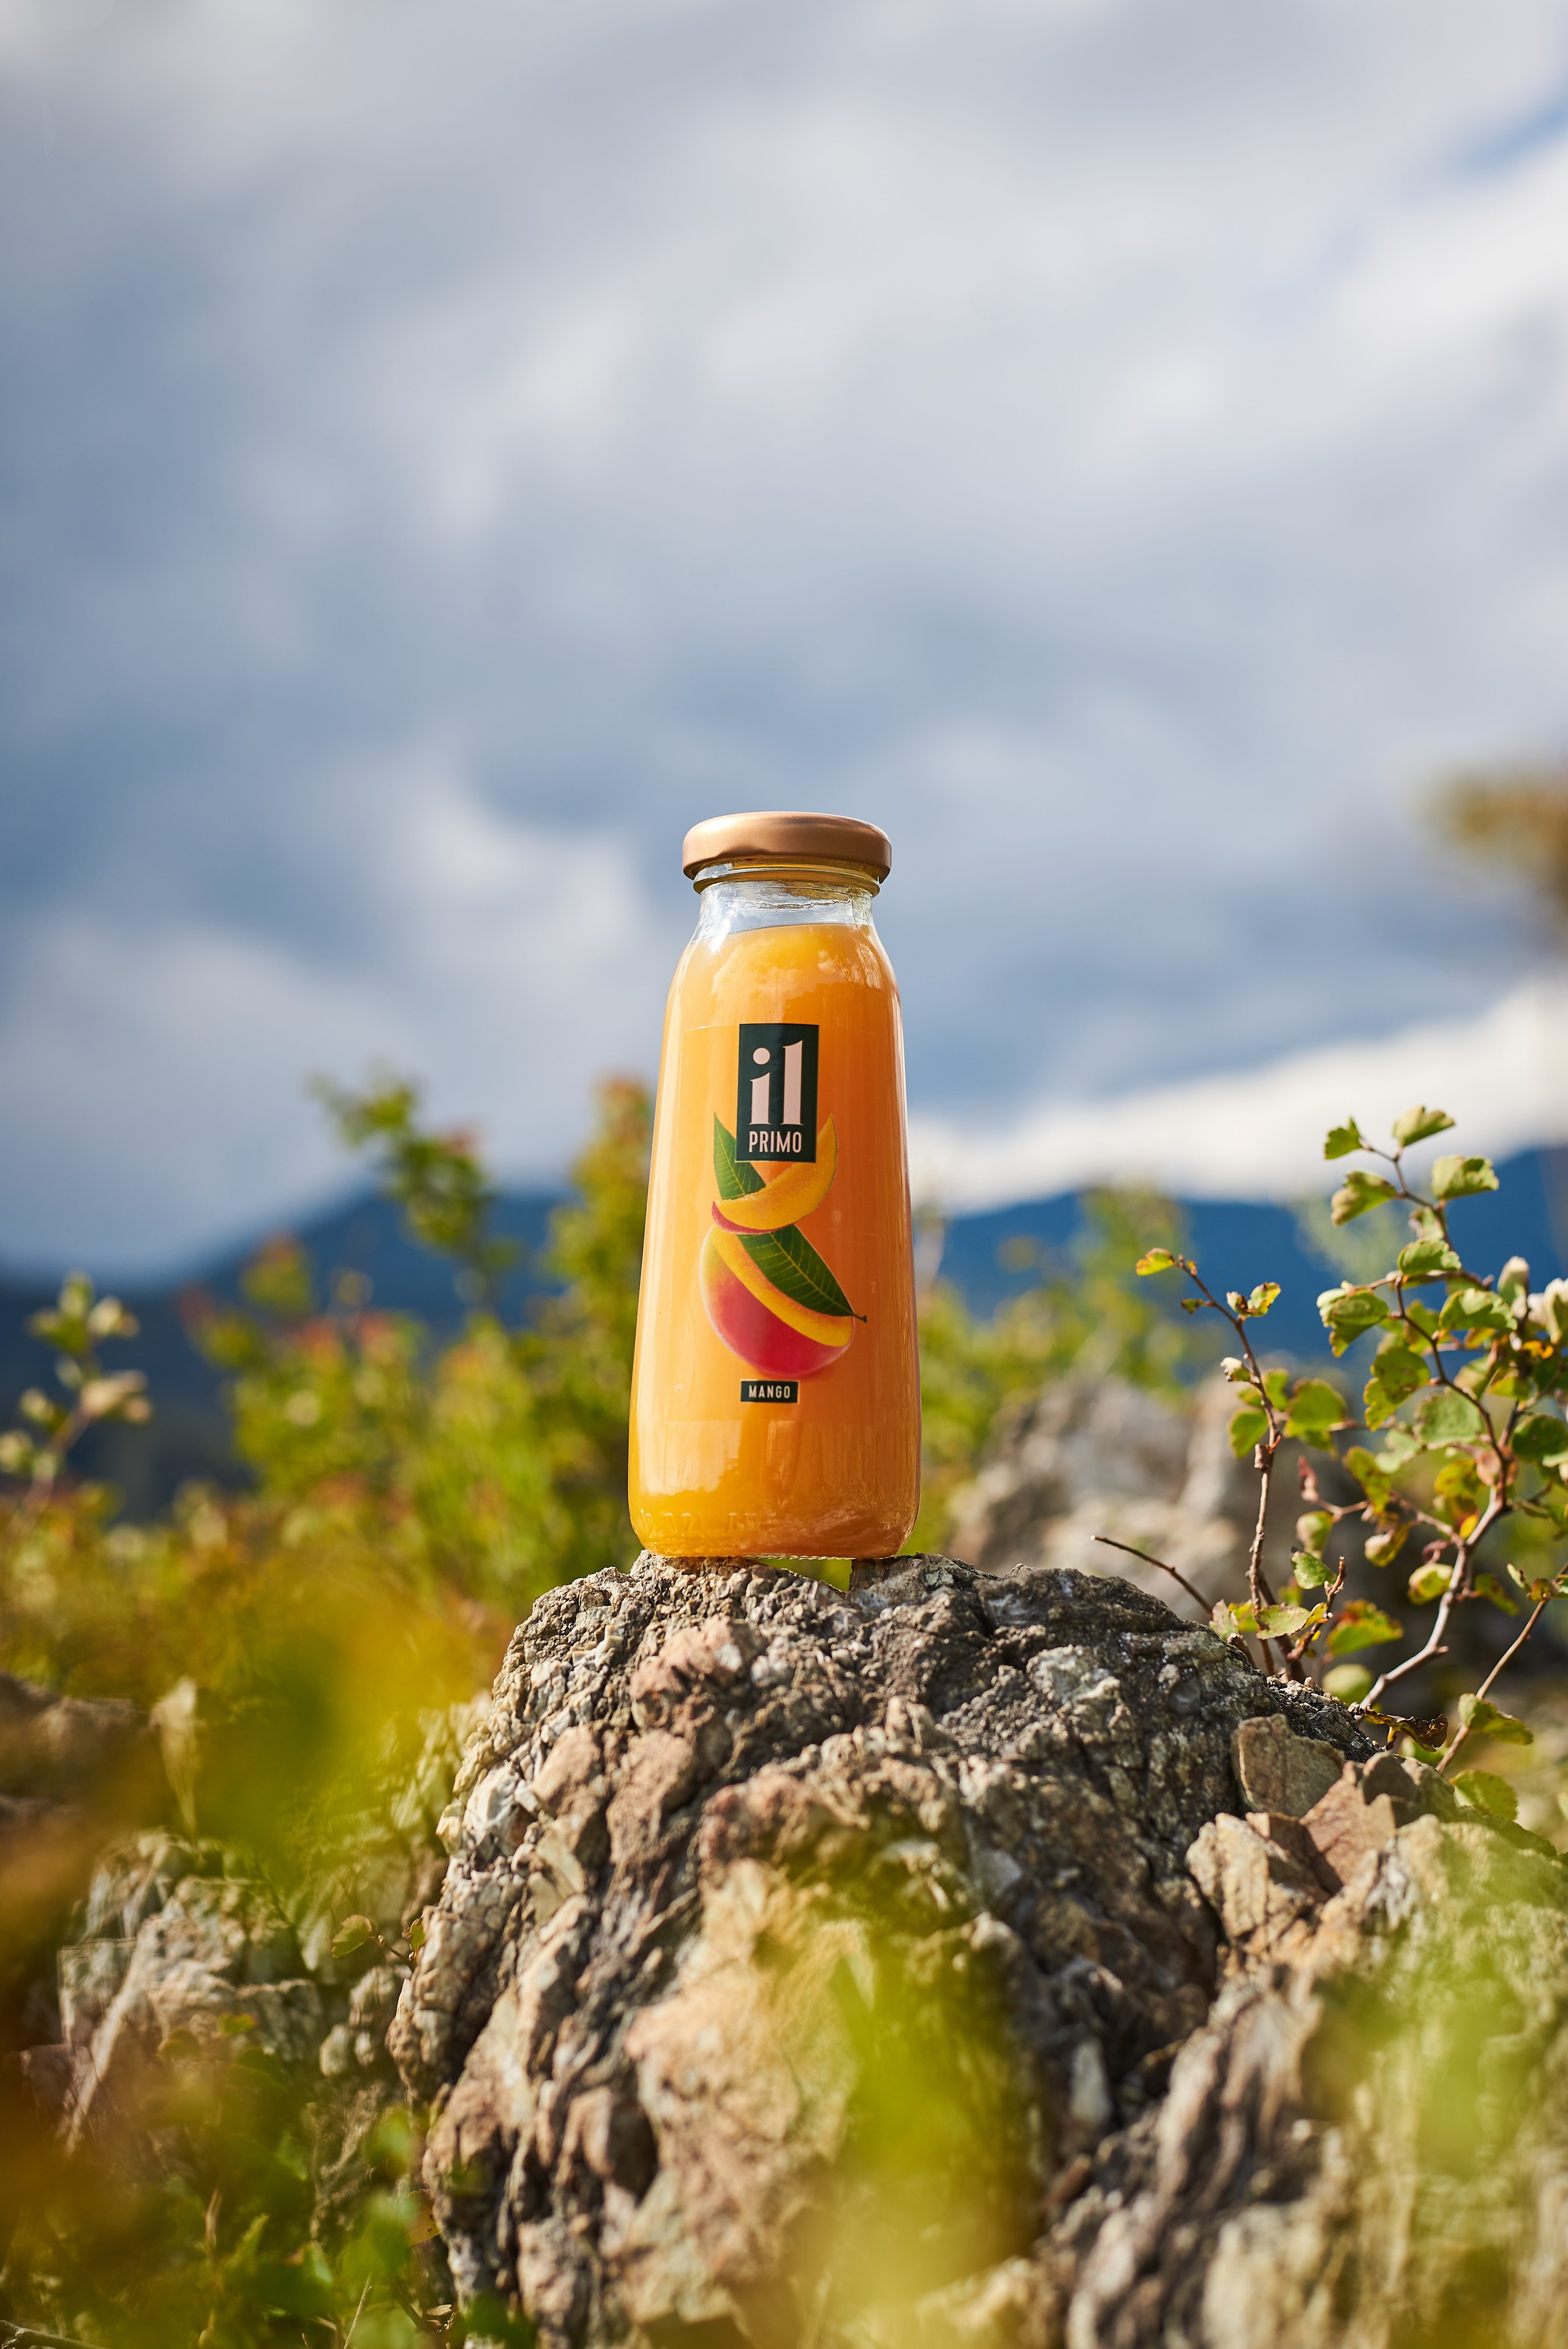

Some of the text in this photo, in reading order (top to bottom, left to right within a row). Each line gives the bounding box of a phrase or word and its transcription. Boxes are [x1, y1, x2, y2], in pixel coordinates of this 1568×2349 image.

[749, 1039, 804, 1126] il
[748, 1131, 802, 1153] PRIMO
[748, 1385, 791, 1399] MANGO
